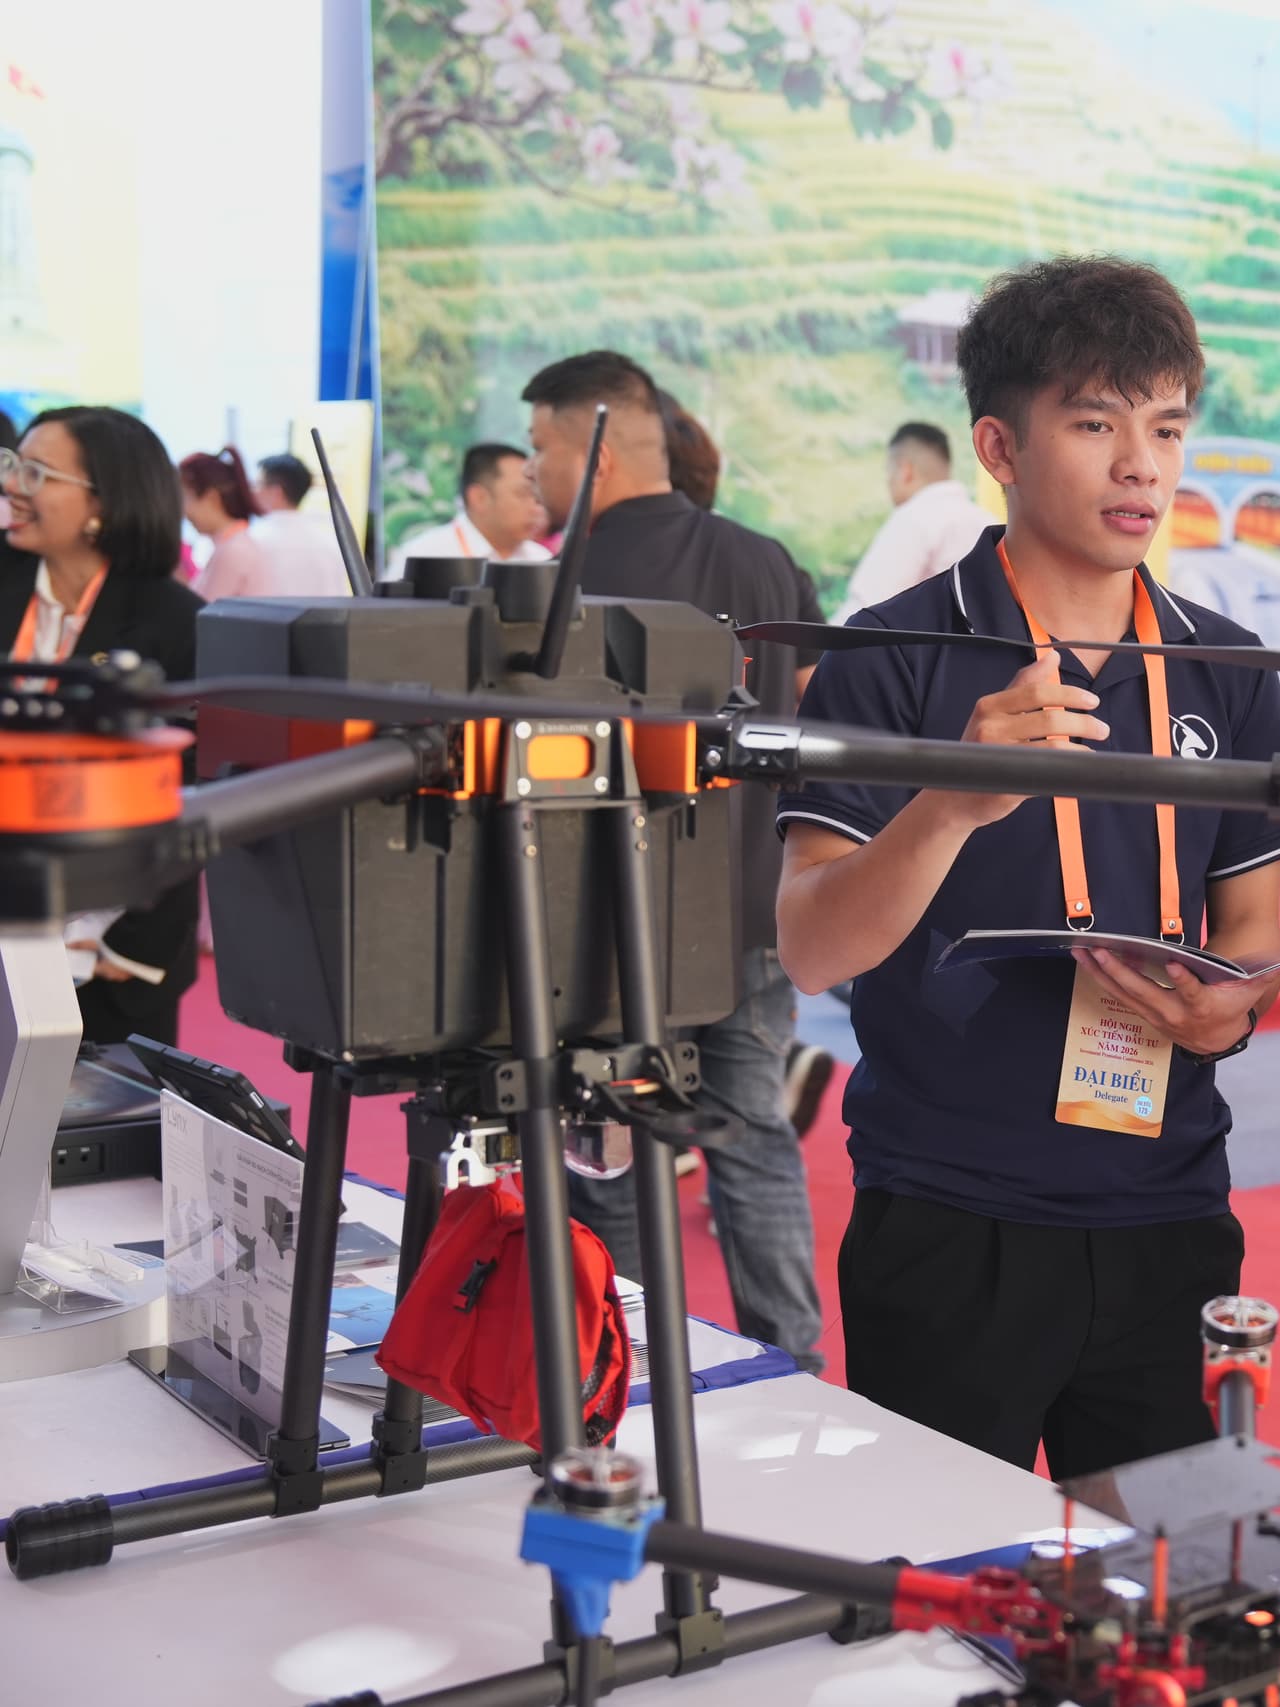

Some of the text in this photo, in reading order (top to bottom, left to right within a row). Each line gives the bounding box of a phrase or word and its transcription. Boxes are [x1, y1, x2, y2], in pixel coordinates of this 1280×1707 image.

[1120, 1046, 1138, 1056] 2026
[1074, 1066, 1153, 1094] ĐẠI BIỂU
[1094, 1089, 1129, 1104] Delegate
